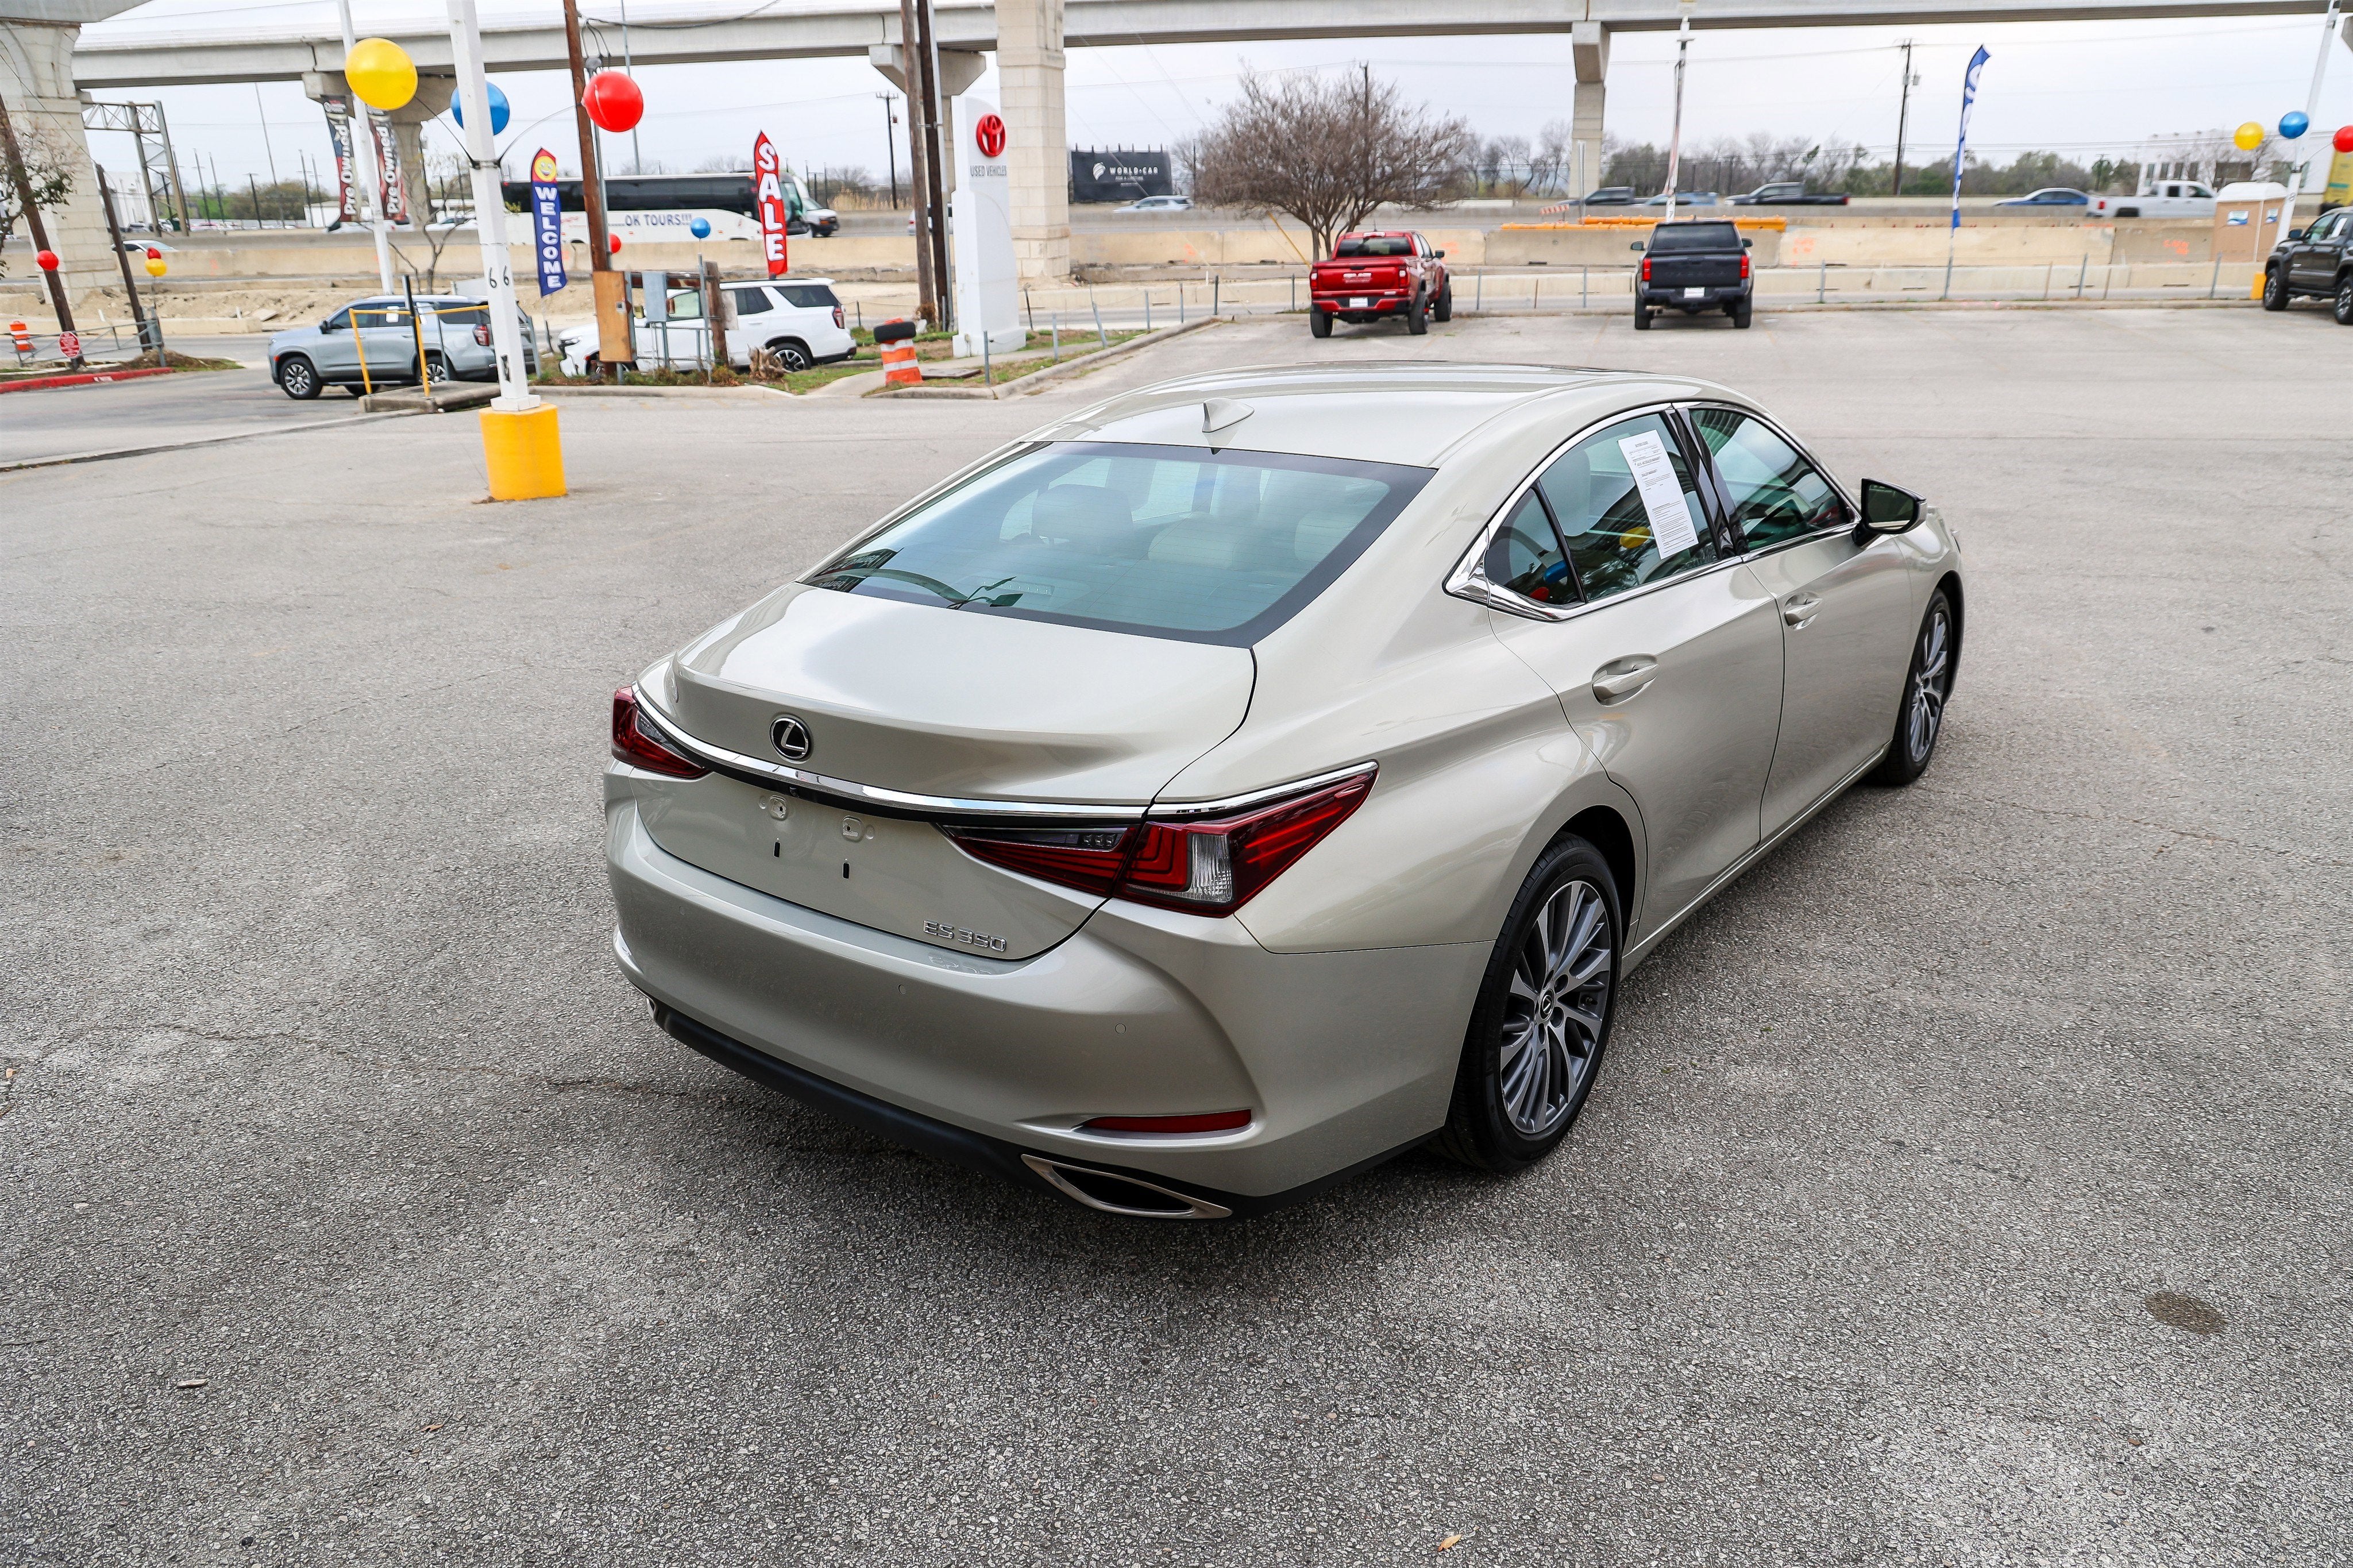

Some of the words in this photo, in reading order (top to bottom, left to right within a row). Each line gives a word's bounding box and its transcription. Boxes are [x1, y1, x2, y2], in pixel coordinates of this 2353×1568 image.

[334, 125, 354, 184] Owned
[375, 126, 397, 184] Owned
[970, 165, 985, 176] USED
[344, 187, 357, 215] Pre
[387, 186, 400, 214] Pre
[758, 142, 785, 261] SALE
[535, 187, 562, 288] WELCOME
[923, 920, 954, 939] ES
[958, 928, 1006, 952] 350
